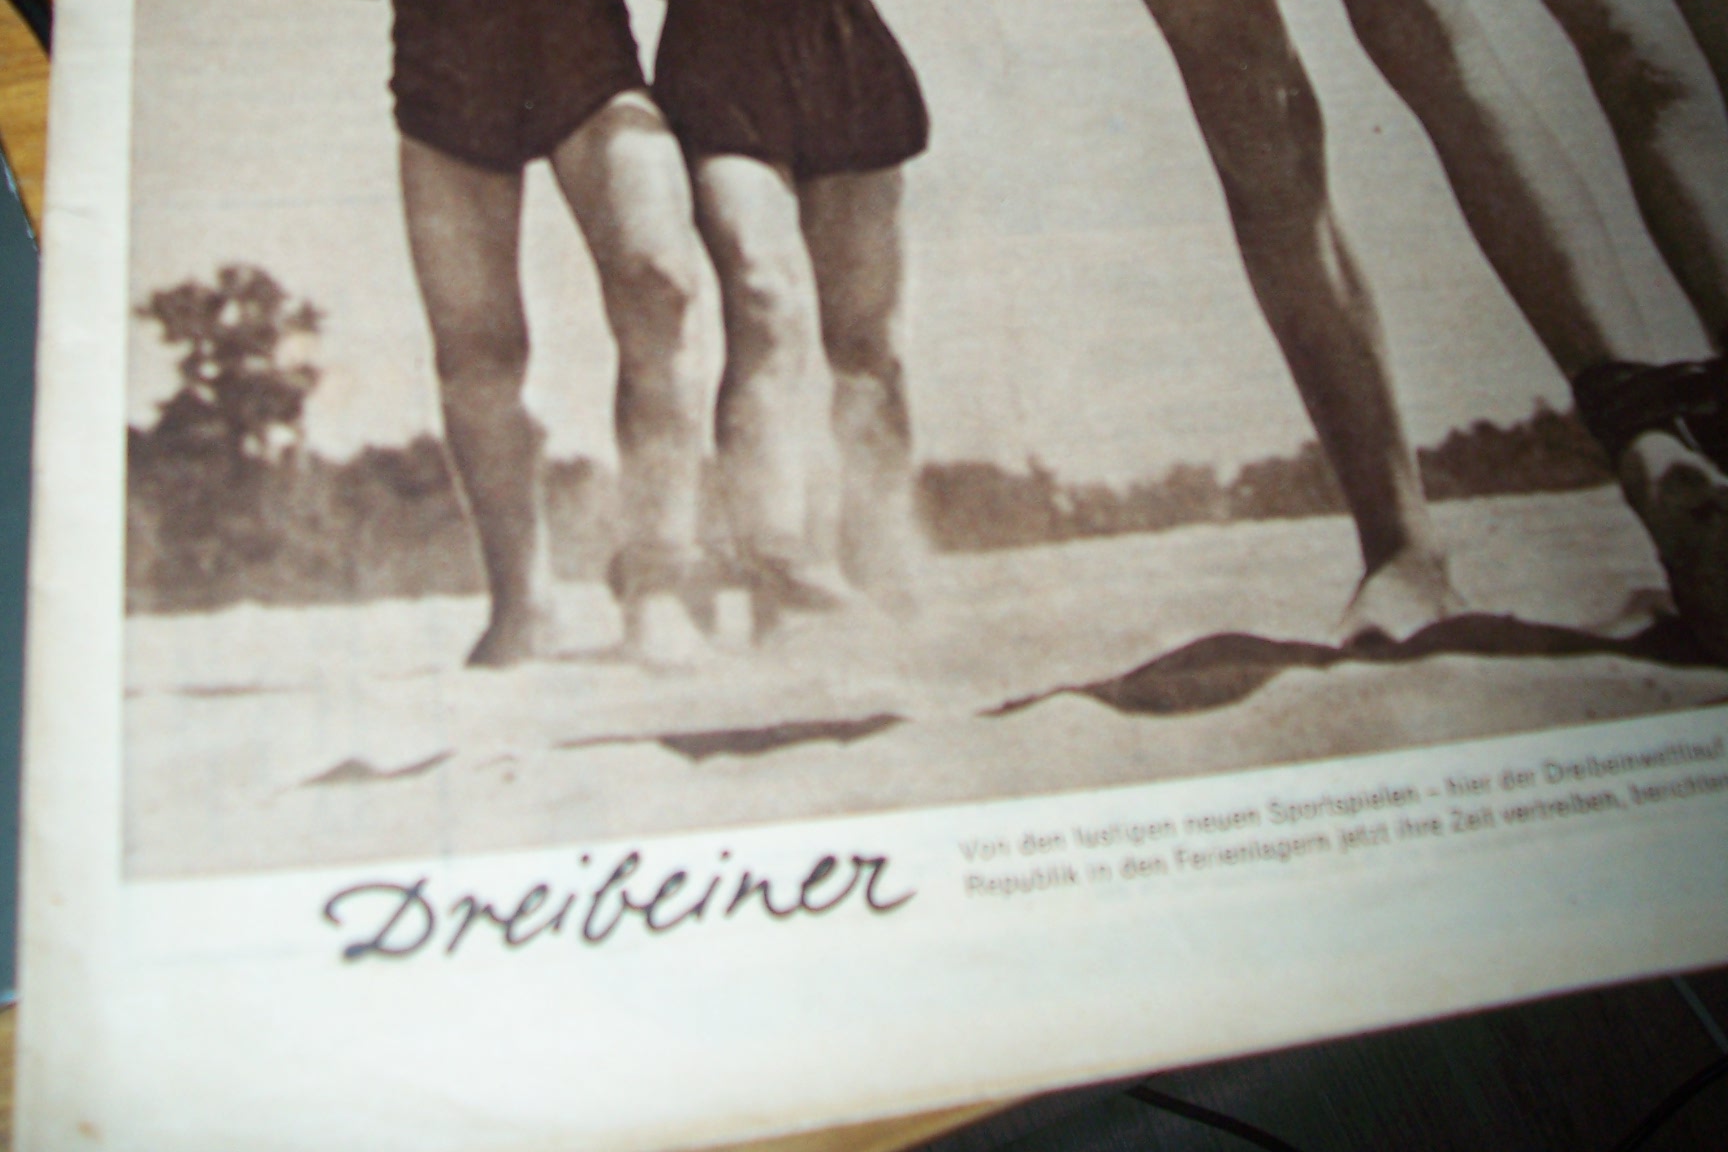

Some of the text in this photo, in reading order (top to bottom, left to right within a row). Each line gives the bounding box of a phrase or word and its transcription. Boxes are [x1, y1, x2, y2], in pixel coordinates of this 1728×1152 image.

[1020, 829, 1067, 856] den
[1183, 808, 1261, 834] neuen
[1449, 806, 1497, 834] Zeit
[322, 850, 919, 967] Dreibeiner
